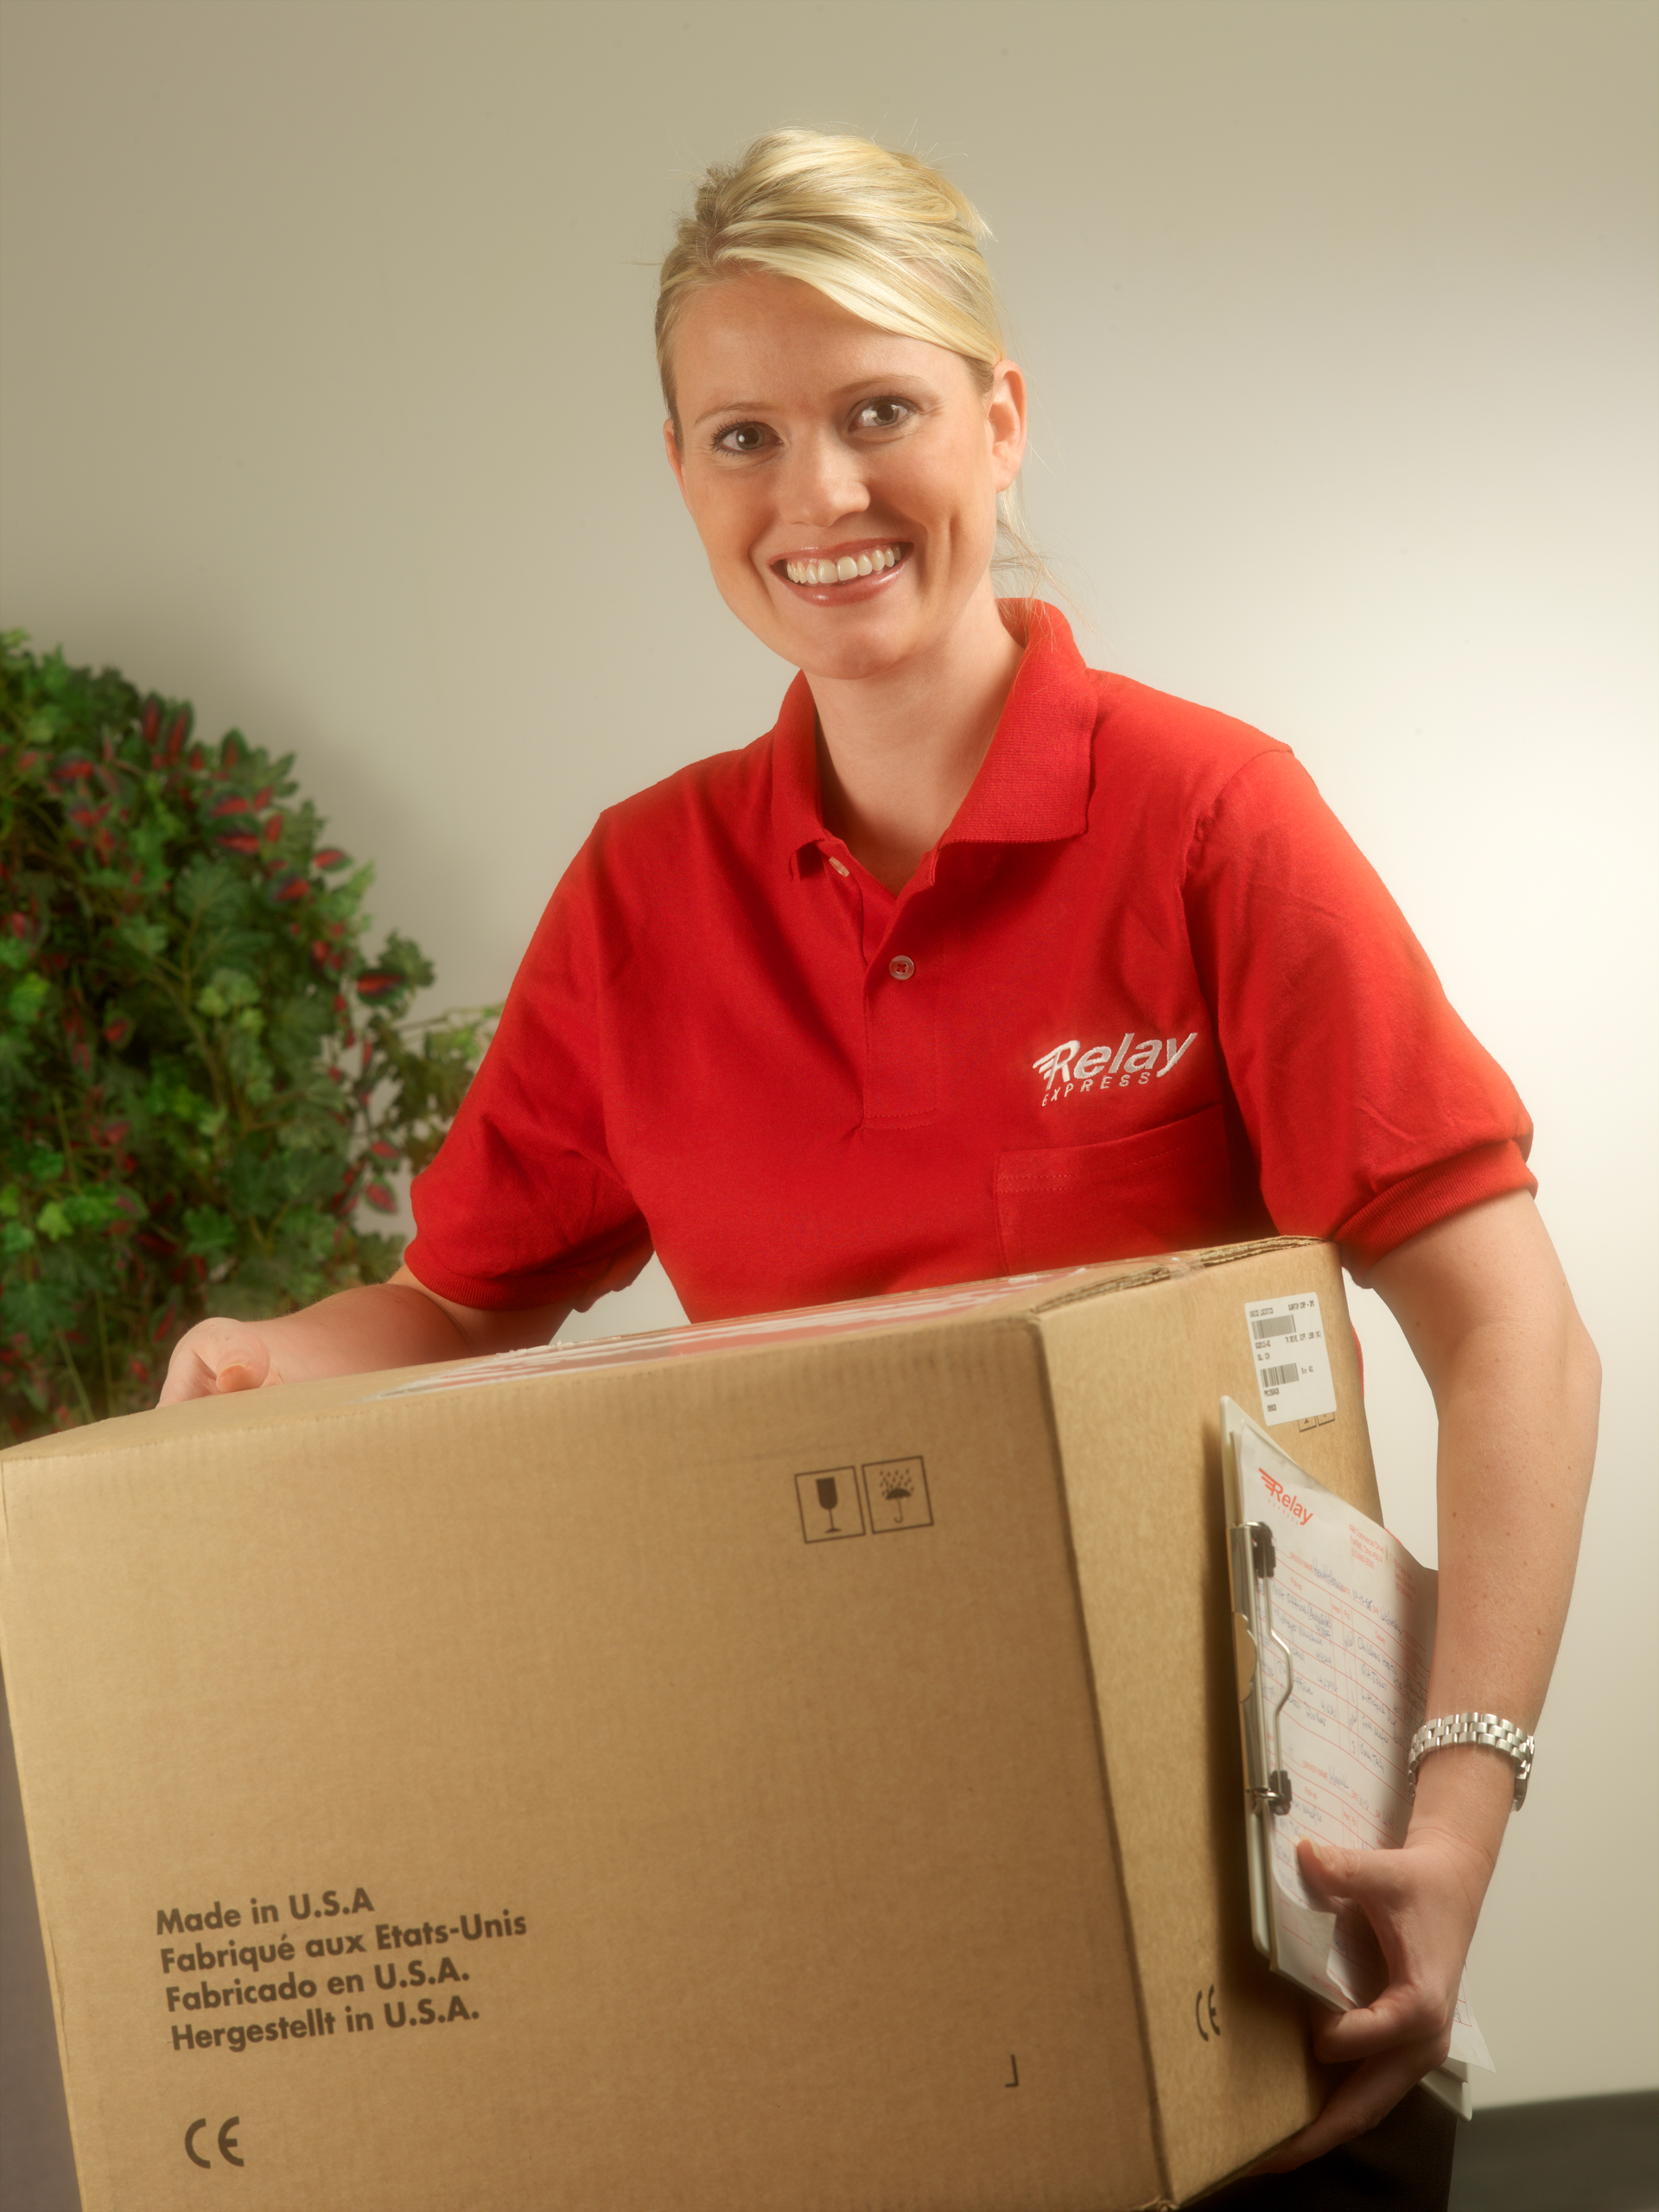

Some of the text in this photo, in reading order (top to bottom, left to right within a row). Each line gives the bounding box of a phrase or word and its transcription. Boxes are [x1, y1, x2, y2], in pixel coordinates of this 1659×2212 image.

[1033, 1032, 1198, 1091] Relay
[1041, 1071, 1151, 1107] EXPRESS
[1258, 1467, 1313, 1526] Relay
[156, 1887, 375, 1936] Made in U.S.A
[160, 1909, 527, 1974] Fabriqué aux Etats-Unis
[166, 1956, 470, 2012] Fabricado en U.S.A.
[171, 1995, 480, 2053] Hergestellt in U.S.A.
[184, 2115, 245, 2170] CE
